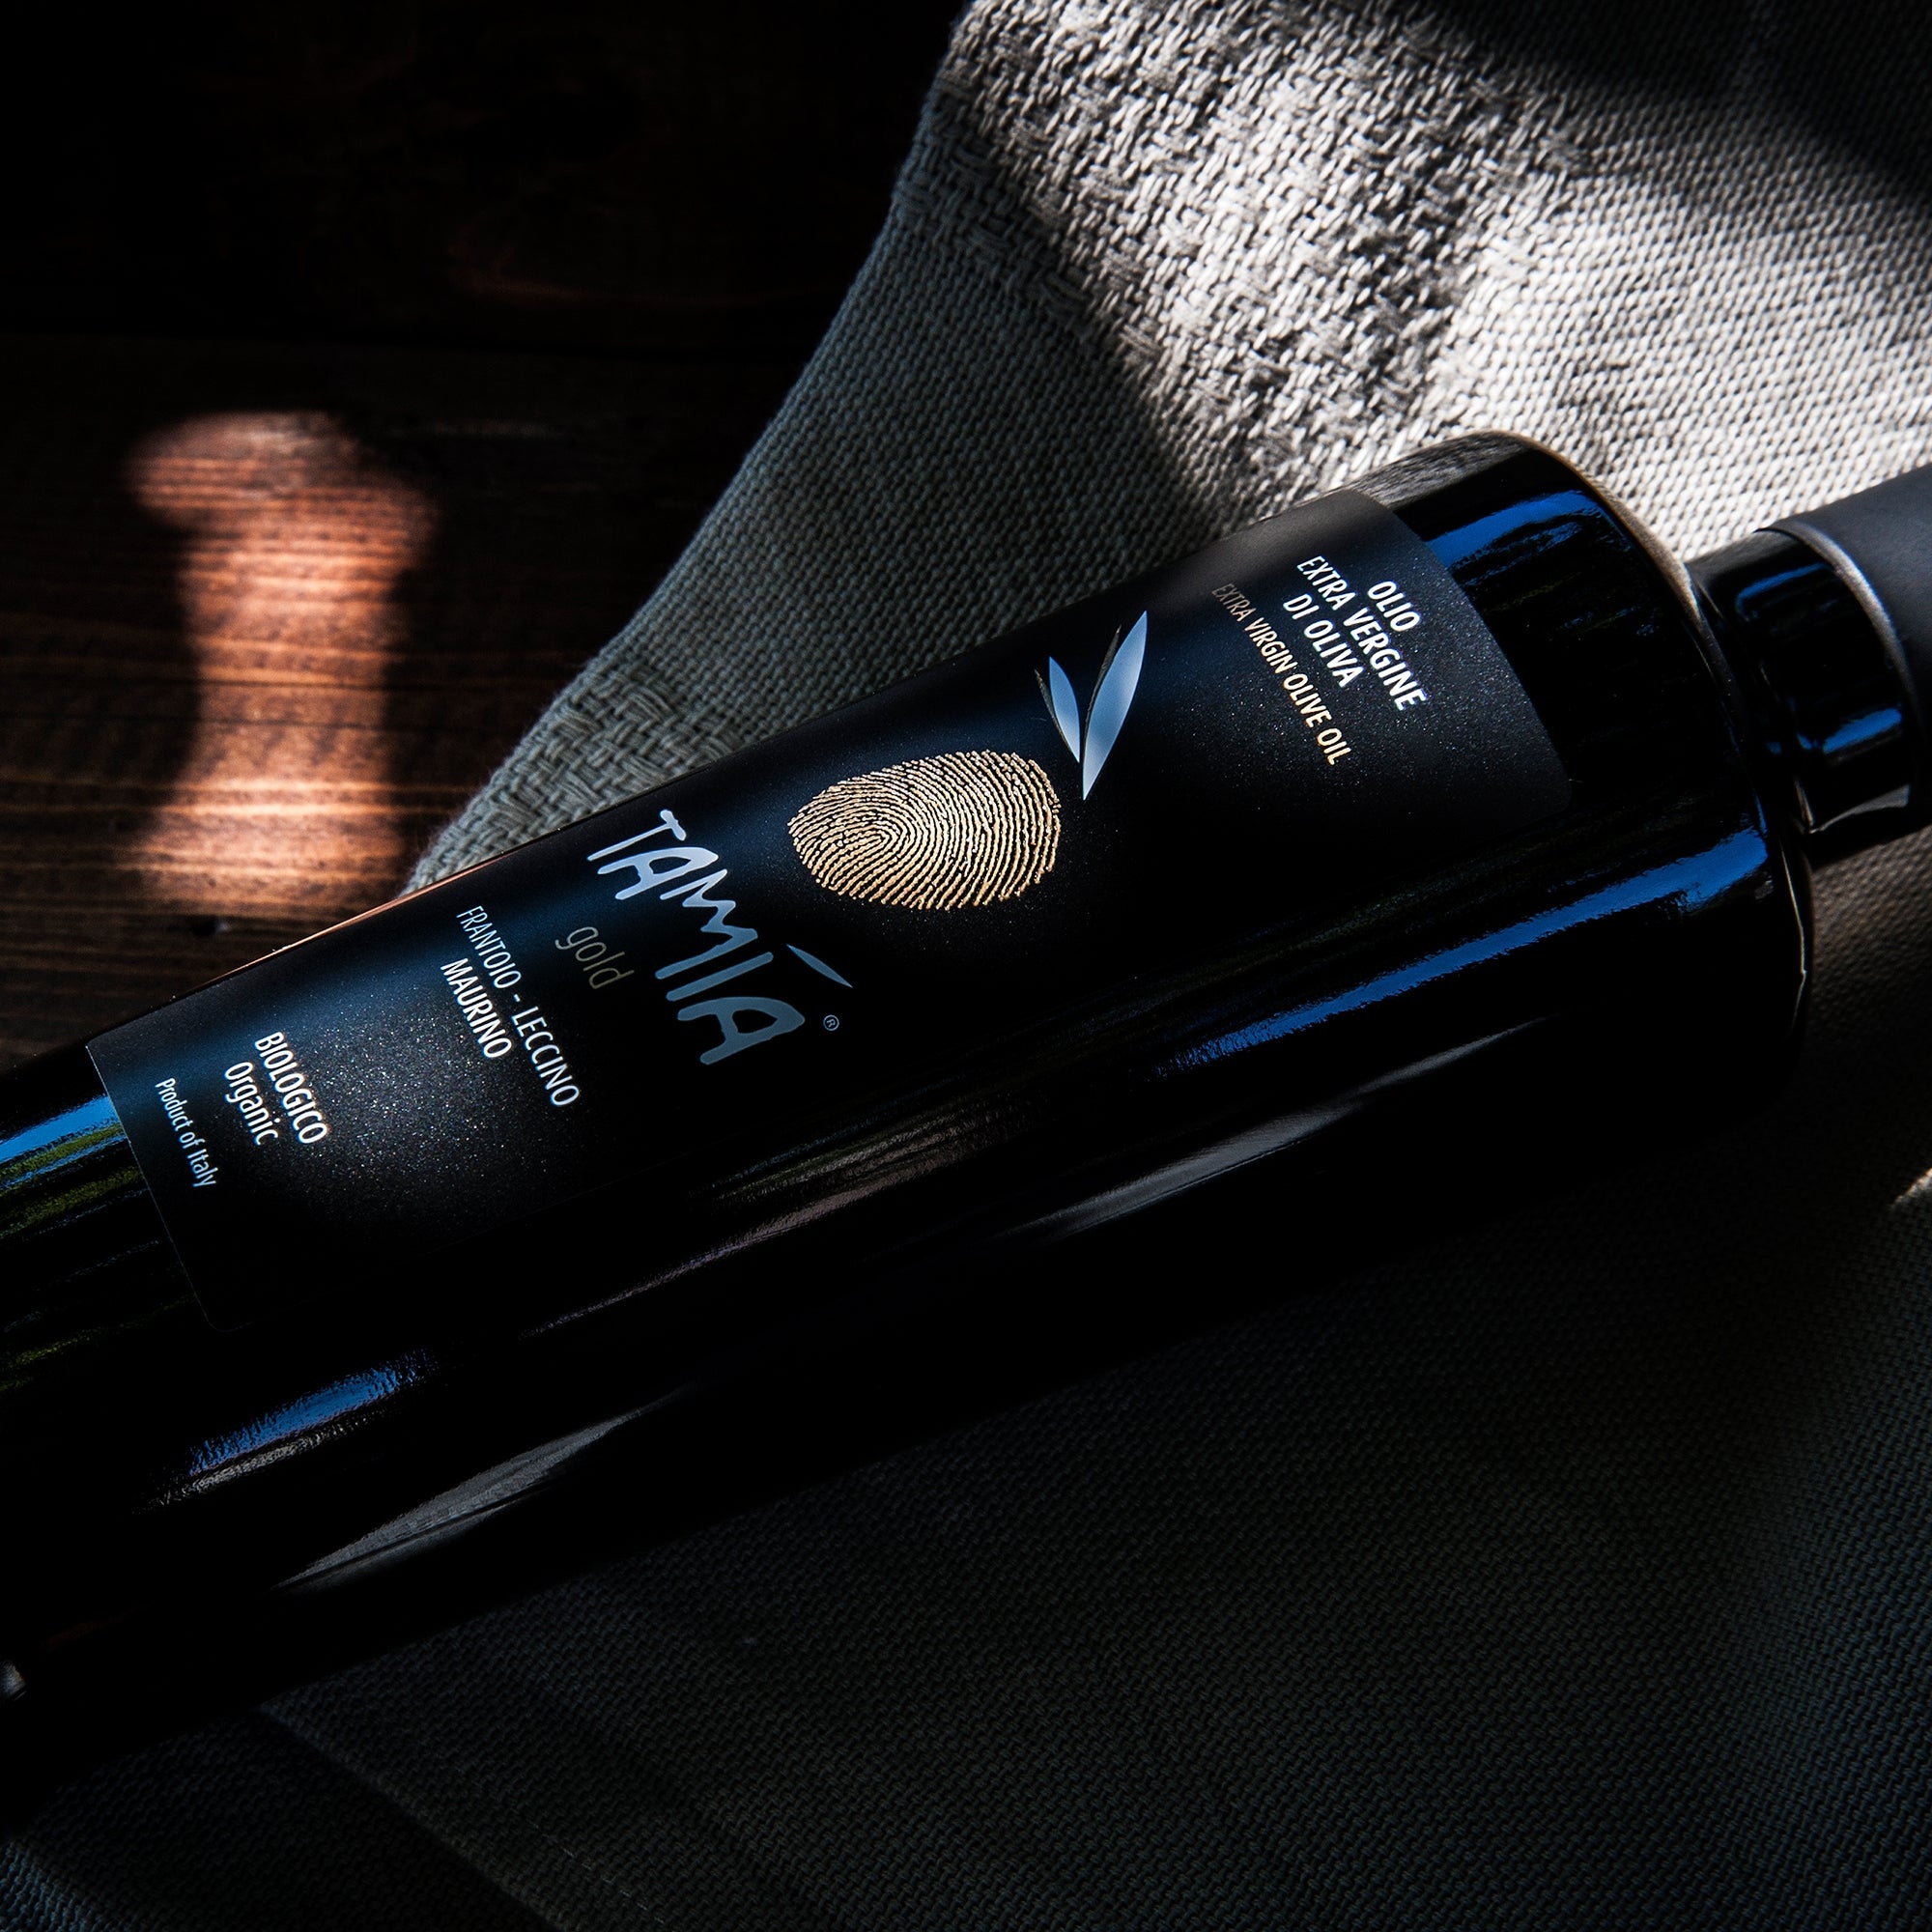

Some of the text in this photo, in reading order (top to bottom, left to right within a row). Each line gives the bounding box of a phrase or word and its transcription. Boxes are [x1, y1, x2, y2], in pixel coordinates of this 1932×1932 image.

[1282, 593, 1365, 688] DI OLIVA
[1295, 554, 1427, 711] EXTRA VERGINE
[1367, 581, 1421, 632] OLIO
[1210, 582, 1351, 766] EXTRA VIRGIN OLIVE OIL
[440, 957, 512, 1058] MAURINO
[456, 905, 523, 989] FRANTOIO
[511, 1006, 581, 1107] LECCINO
[554, 926, 635, 989] gold
[822, 1013, 839, 1031] ®
[155, 1077, 218, 1188] Product of Italy
[224, 1062, 280, 1146] Organic
[254, 1031, 329, 1145] BIOLOGICO
